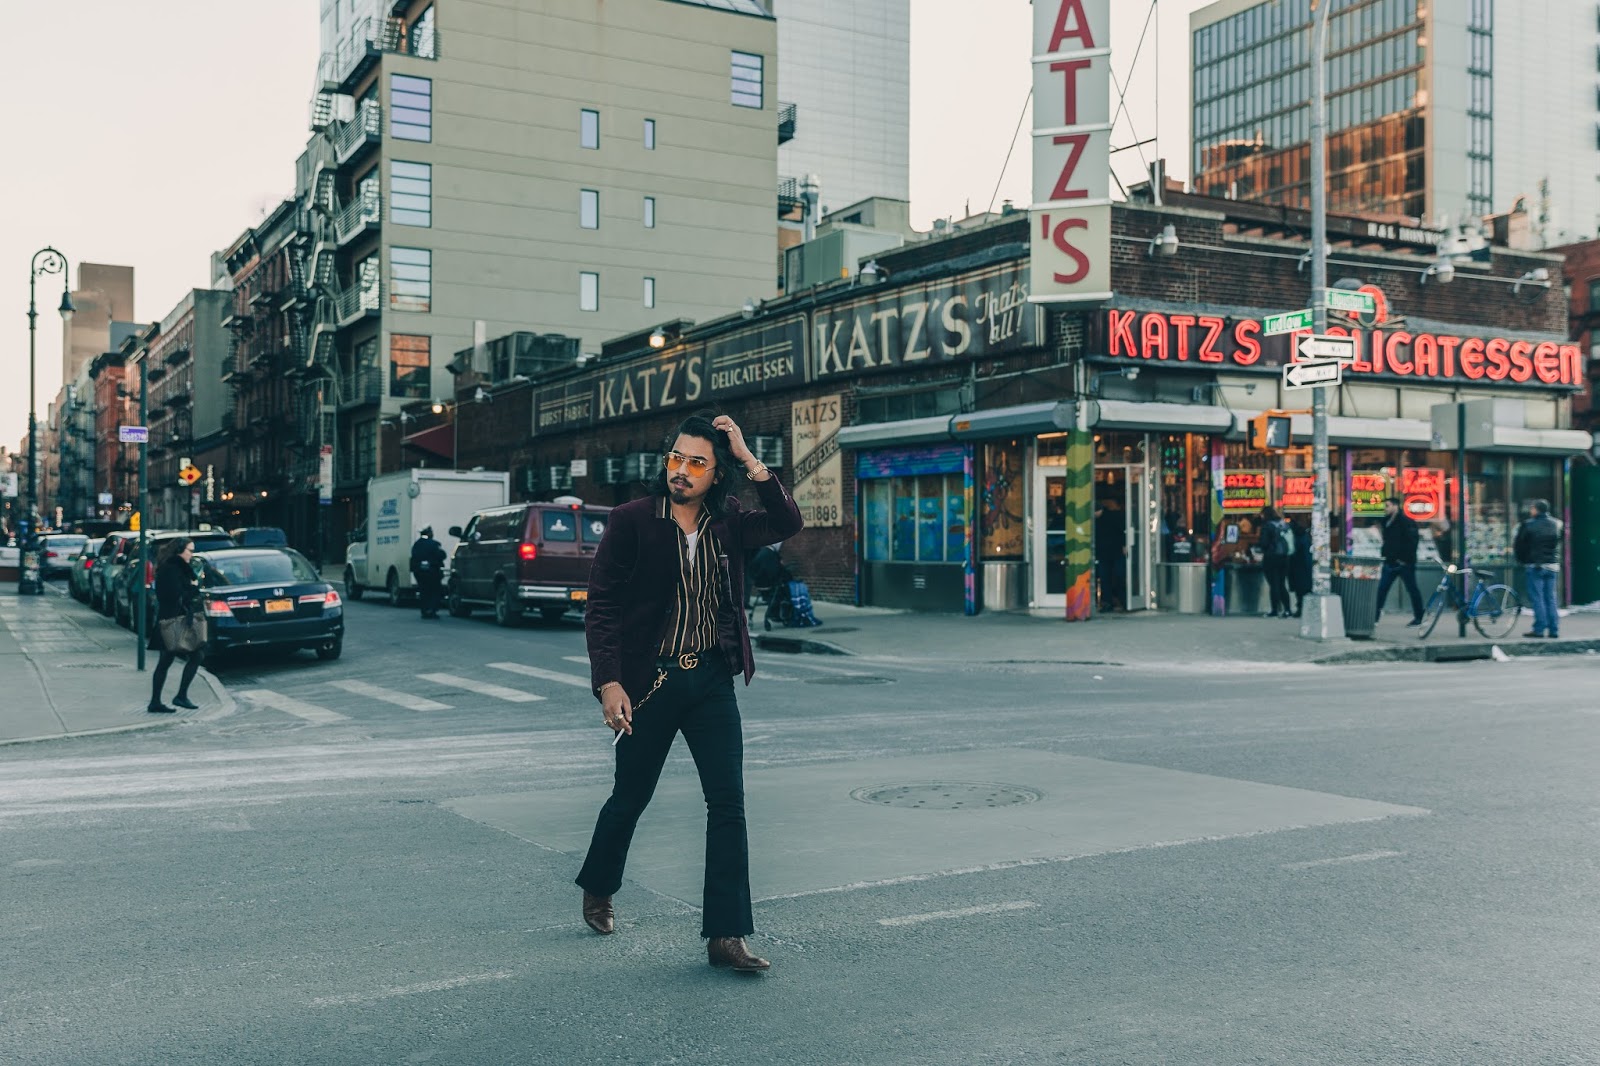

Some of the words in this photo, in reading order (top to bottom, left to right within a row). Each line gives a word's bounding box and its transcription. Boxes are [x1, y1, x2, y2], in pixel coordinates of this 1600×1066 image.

[817, 294, 972, 375] KATZ'S
[1265, 315, 1302, 334] Ludlow
[598, 356, 702, 420] KATZ'S
[711, 354, 794, 390] DELICATESSEN
[794, 401, 838, 427] KATZ'S
